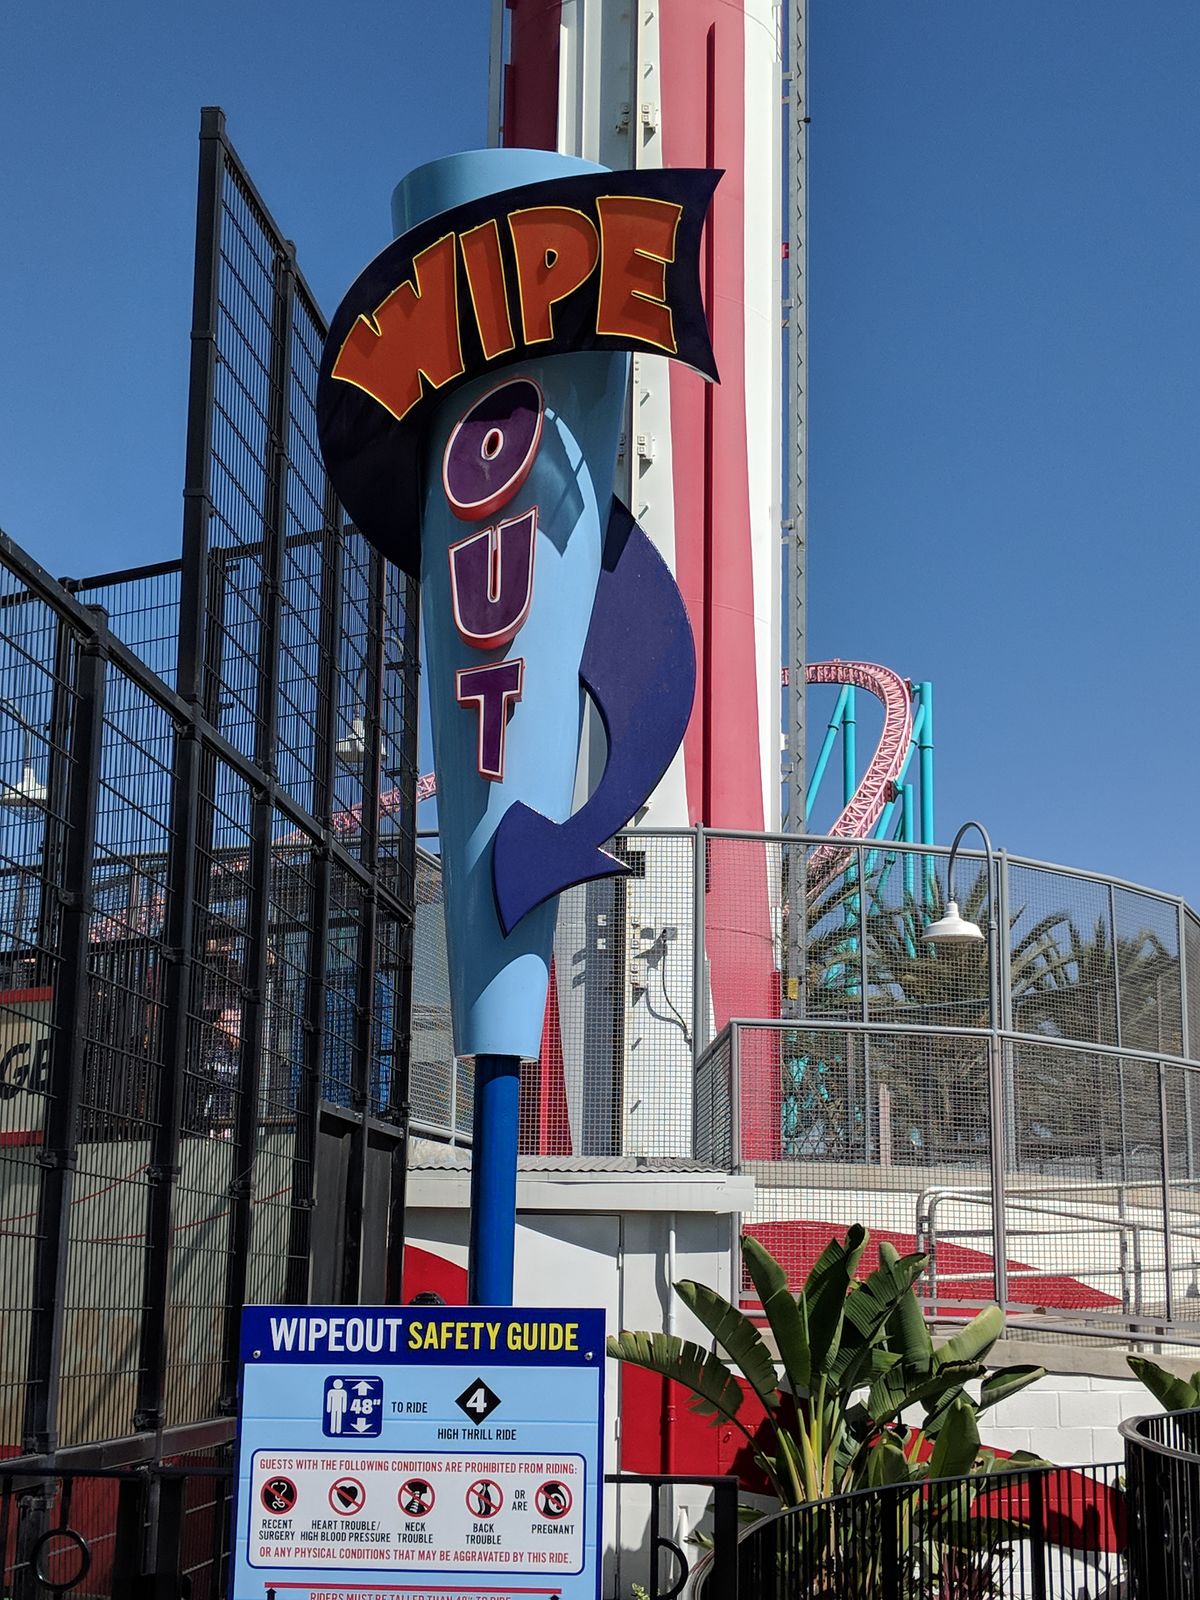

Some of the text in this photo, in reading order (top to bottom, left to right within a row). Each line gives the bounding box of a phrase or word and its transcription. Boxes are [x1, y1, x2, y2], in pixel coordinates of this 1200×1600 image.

[331, 194, 683, 421] WIPE
[442, 376, 545, 783] OUT
[270, 1317, 579, 1352] WIPEOUT SAFETY GUIDE
[466, 1388, 487, 1413] 4
[350, 1398, 428, 1415] 48" TO RIDE
[437, 1428, 517, 1440] HIGH THRILL RIDE
[260, 1459, 577, 1474] GUESTS WITH THE FOLLOWING CONDITIONS ARE PROHIBITED FROM RIDING:
[514, 1489, 526, 1499] OR
[511, 1501, 528, 1511] ARE
[262, 1519, 293, 1529] RECENT
[311, 1520, 381, 1531] HEART TROUBLE/
[405, 1522, 426, 1532] NECK
[473, 1523, 494, 1533] BACK
[531, 1524, 575, 1535] PREGNANT
[258, 1531, 295, 1541] SURGERY
[300, 1531, 391, 1543] HIGH BLOOD PRESSURE
[397, 1533, 433, 1543] TROUBLE
[465, 1534, 502, 1545] TROUBLE
[259, 1546, 572, 1564] OR ANY PHYSICAL CONDITIONS THAT MAY BE AGGRAVATED BY THIS RIDE.
